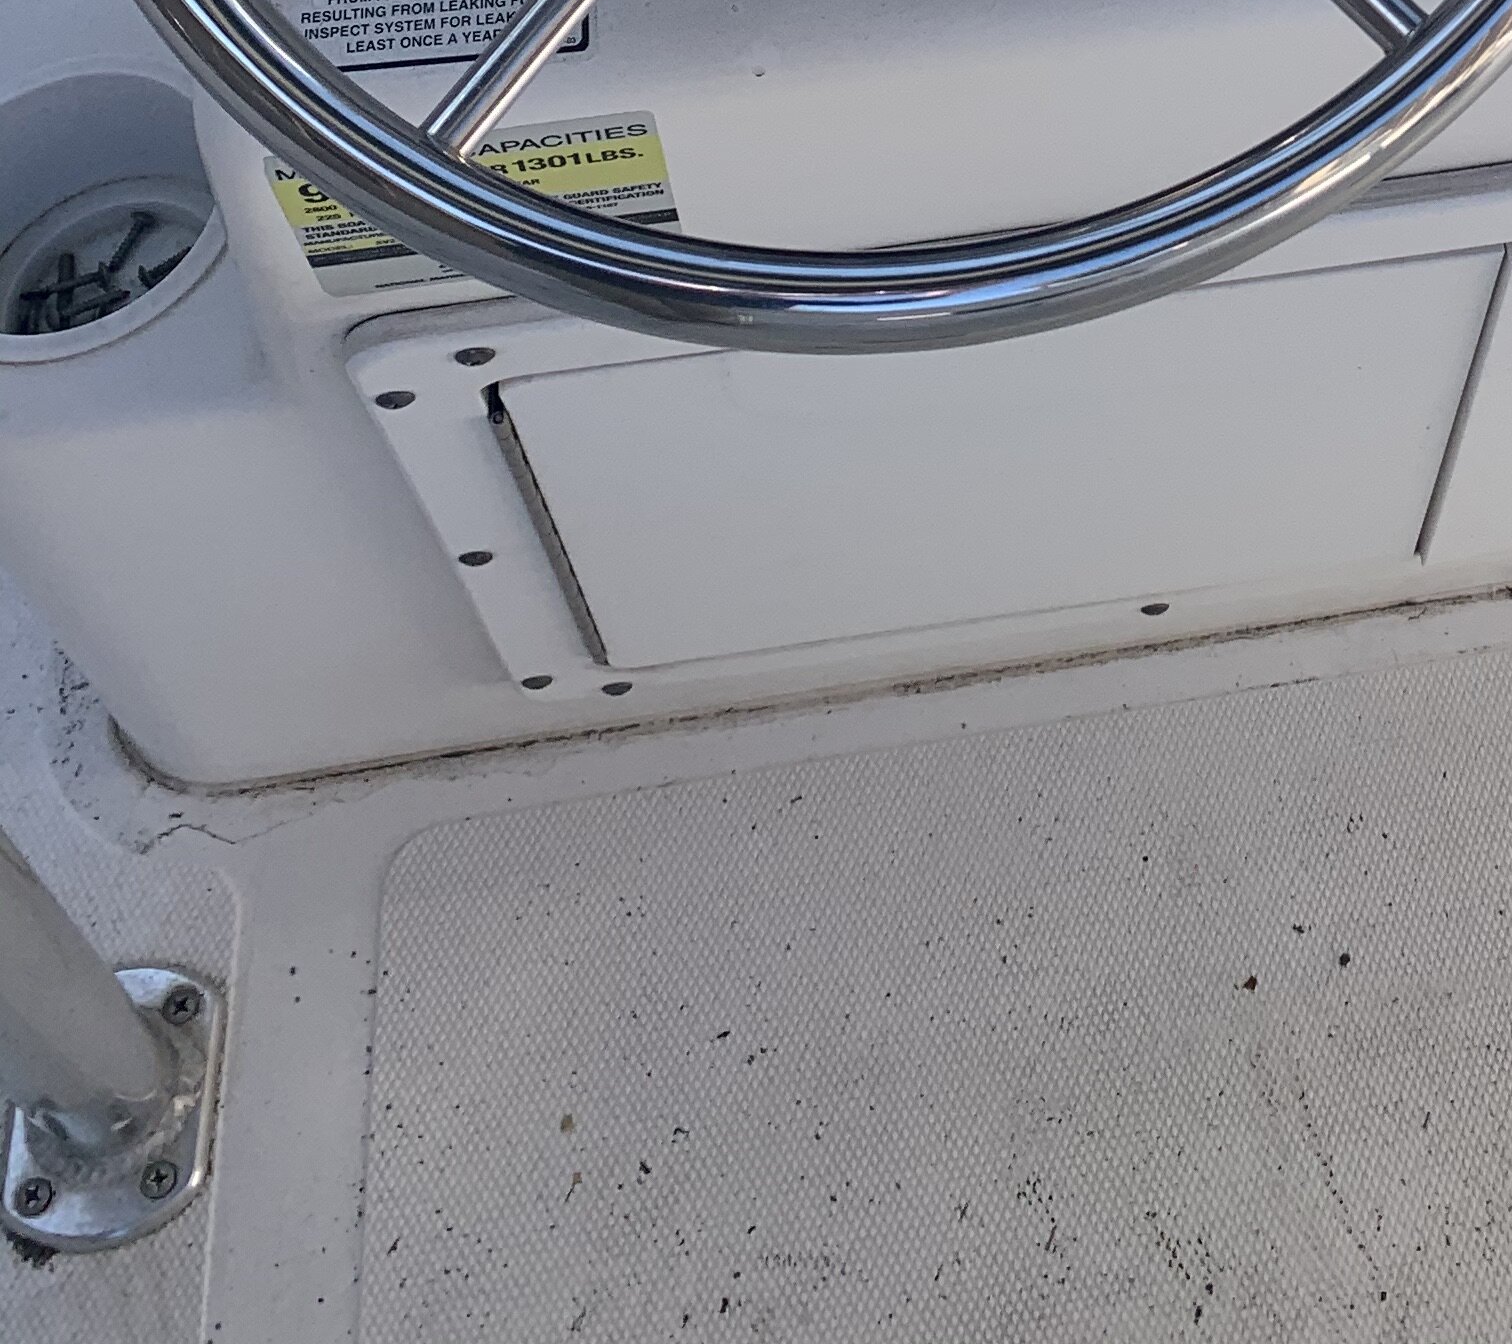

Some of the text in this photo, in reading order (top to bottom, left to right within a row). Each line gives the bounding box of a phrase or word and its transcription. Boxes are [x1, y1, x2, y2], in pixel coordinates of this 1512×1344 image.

[301, 6, 386, 24] RESULTING
[392, 1, 435, 17] FROM
[305, 24, 369, 40] INSPECT
[374, 19, 435, 34] SYSTEM
[440, 15, 471, 29] FOR
[347, 38, 396, 54] LEAST
[400, 34, 443, 49] ONCE
[447, 33, 458, 45] A
[470, 123, 648, 157] APACITIES
[302, 182, 661, 233] THIS BOA GUARD SAFETY
